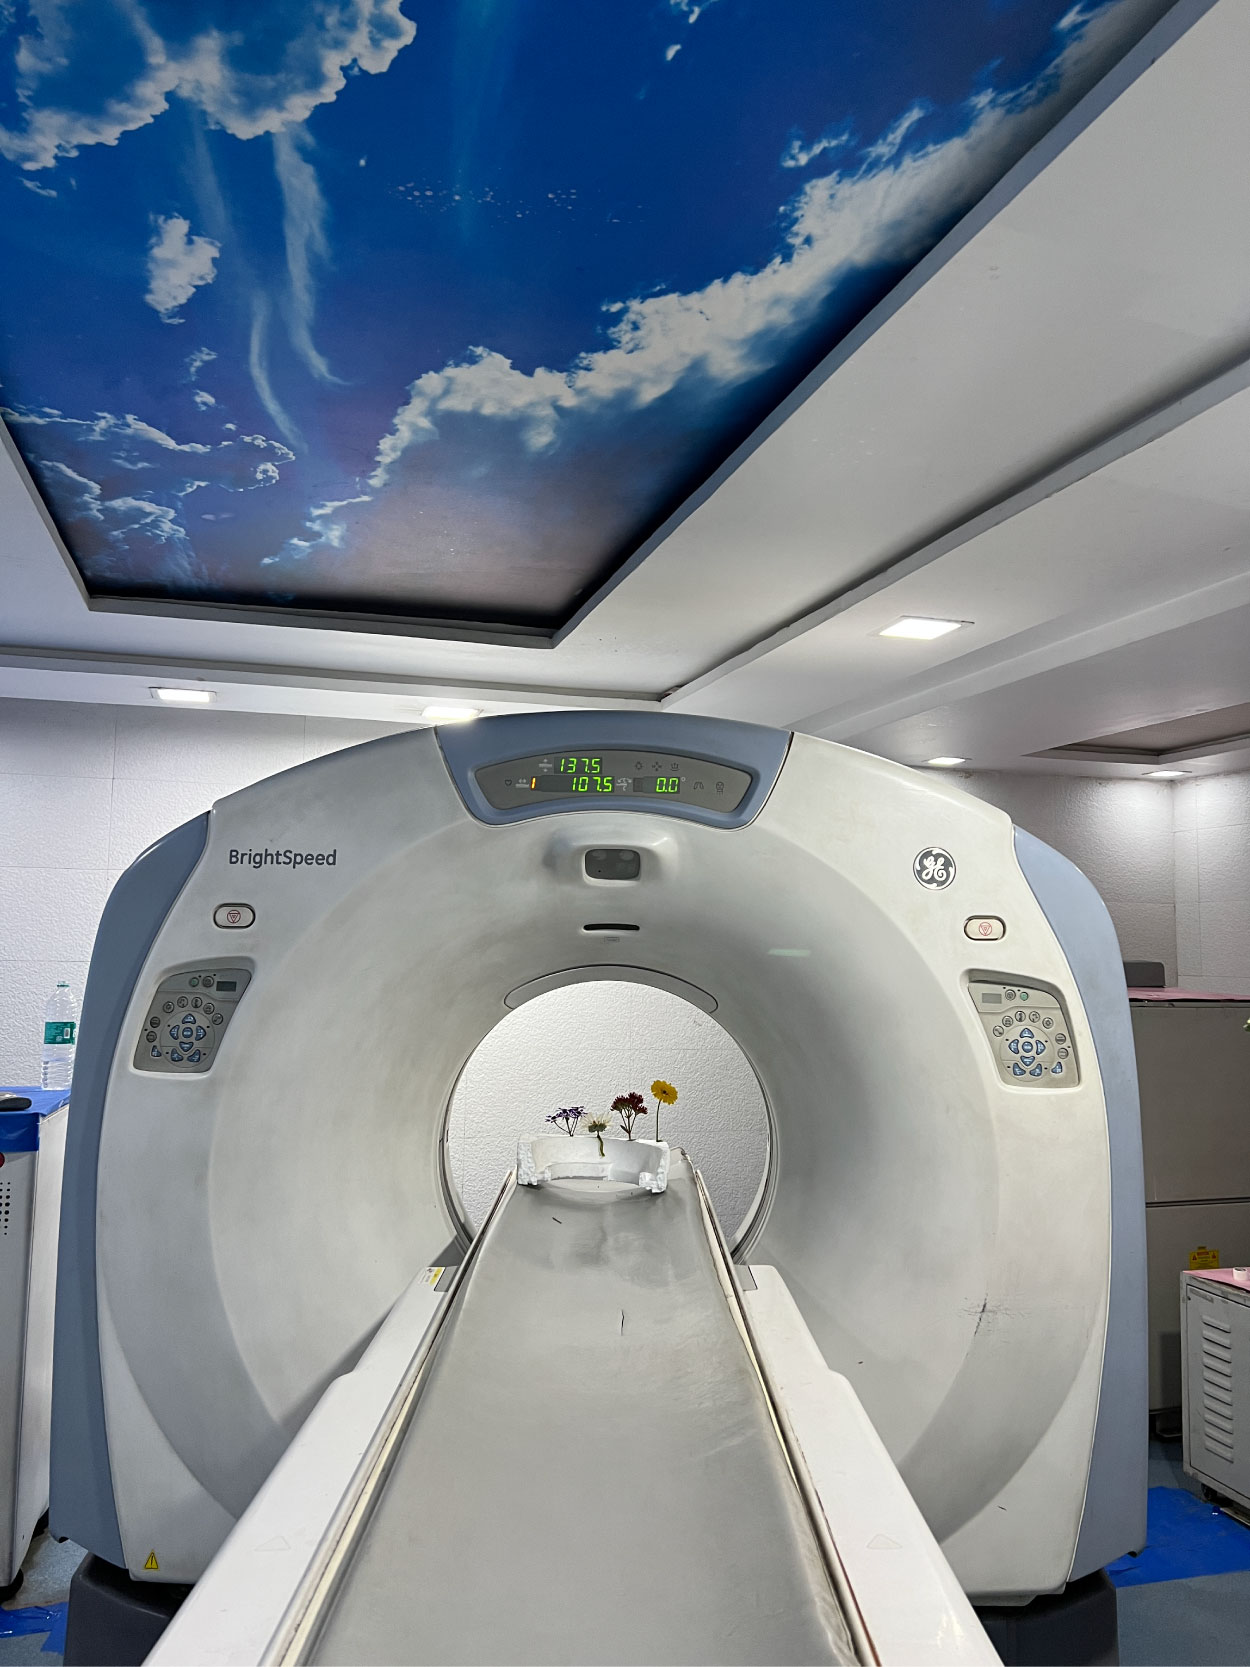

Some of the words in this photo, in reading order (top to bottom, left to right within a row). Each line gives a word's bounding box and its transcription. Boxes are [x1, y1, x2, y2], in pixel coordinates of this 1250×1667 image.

[560, 758, 601, 773] 137.5
[572, 776, 613, 792] 107.5
[229, 848, 337, 869] BrightSpeed
